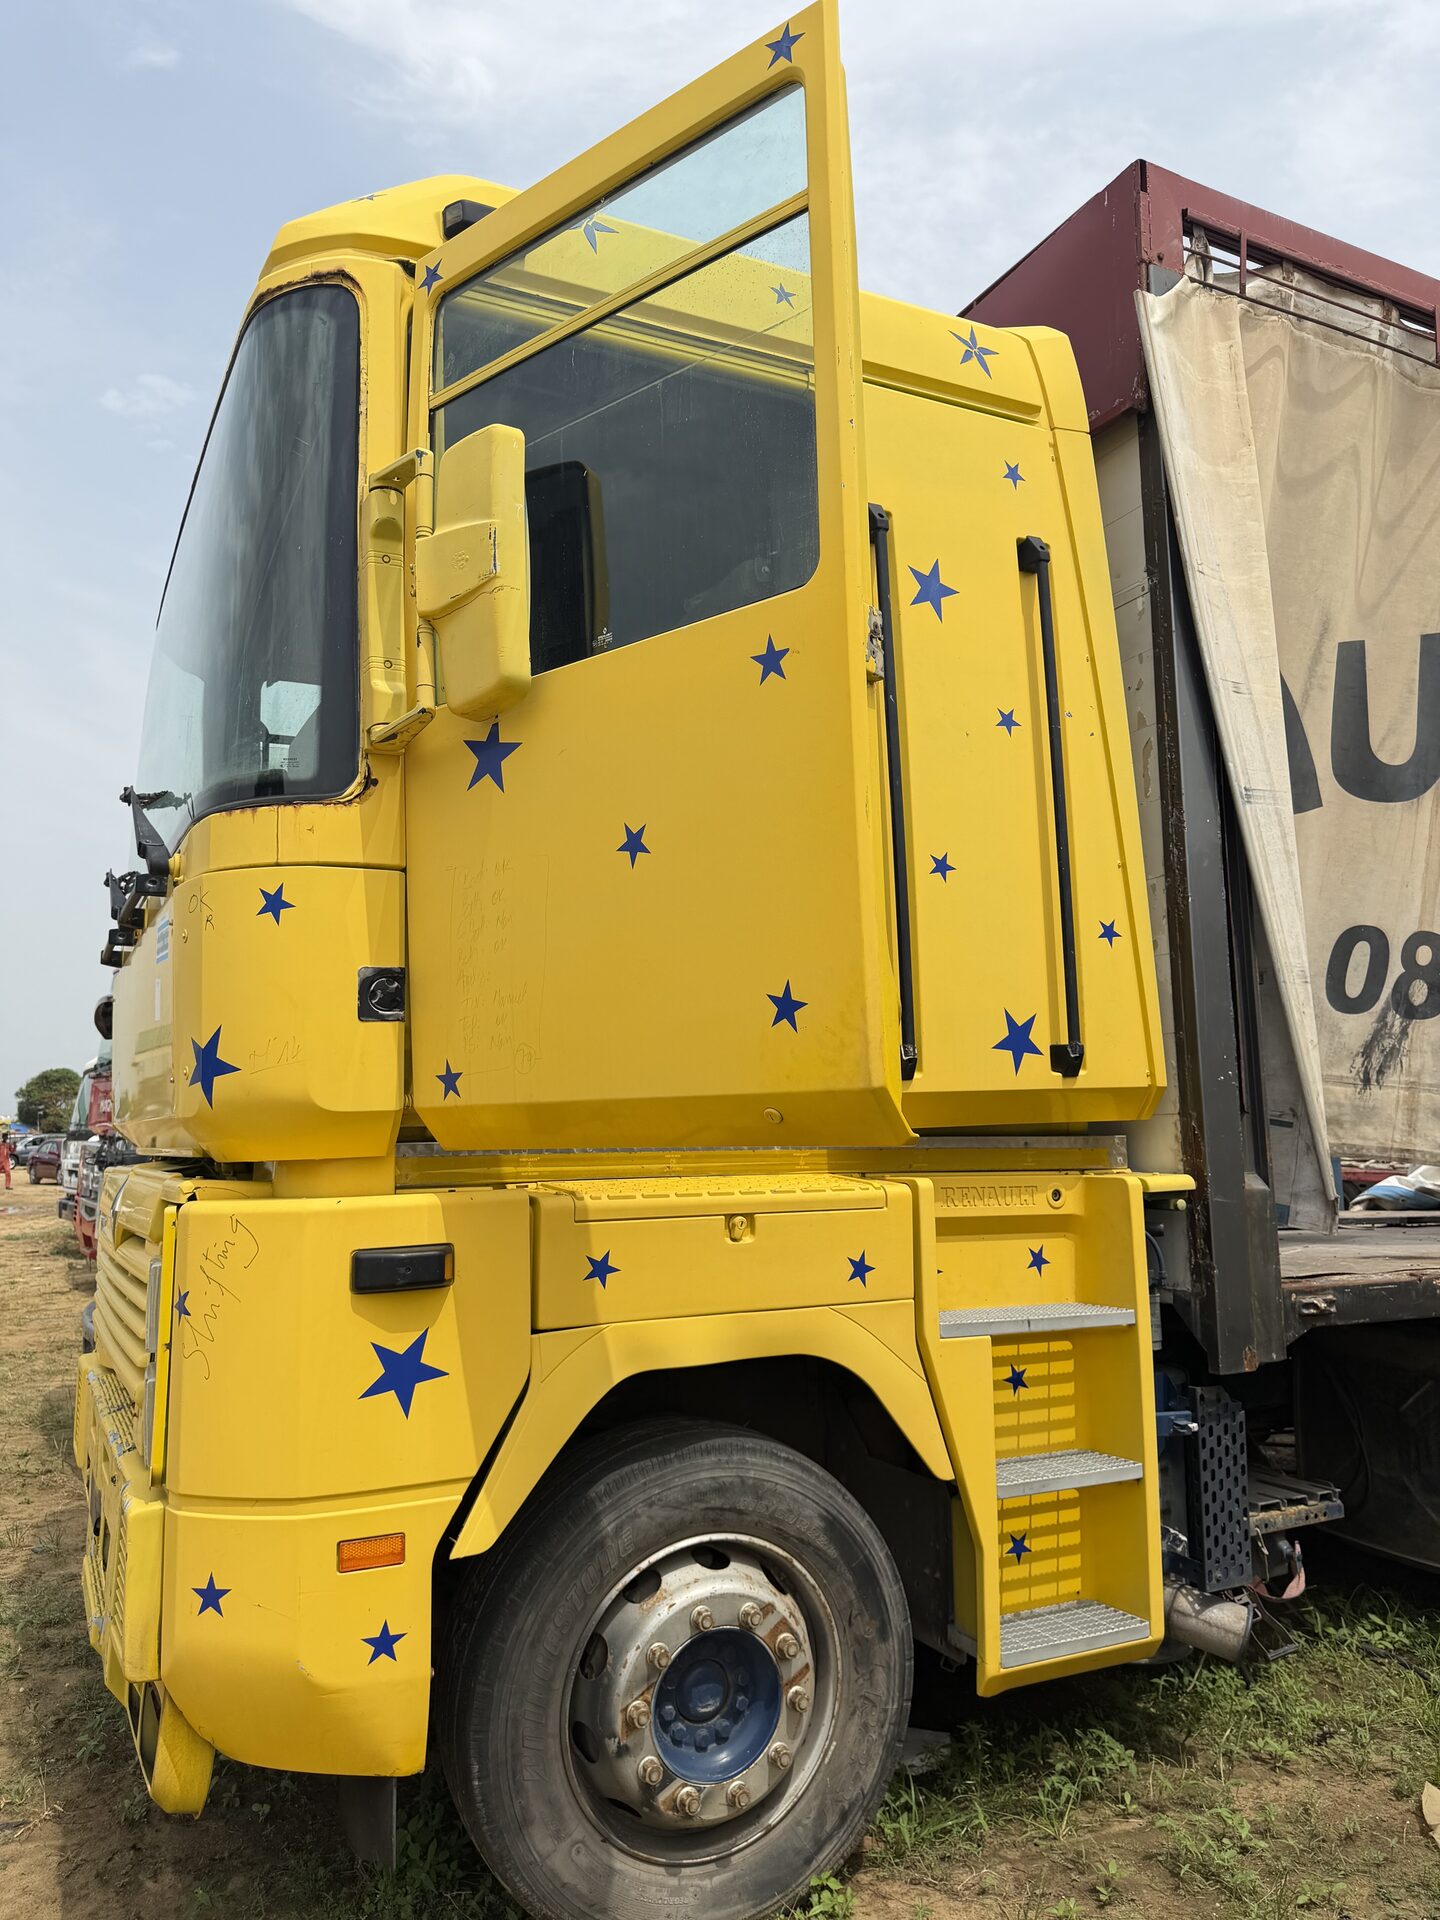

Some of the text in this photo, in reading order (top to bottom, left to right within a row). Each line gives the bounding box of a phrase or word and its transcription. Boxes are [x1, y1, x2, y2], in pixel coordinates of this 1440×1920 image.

[188, 886, 214, 914] OK
[1325, 924, 1440, 1021] 08
[940, 1185, 1038, 1208] RENAULT
